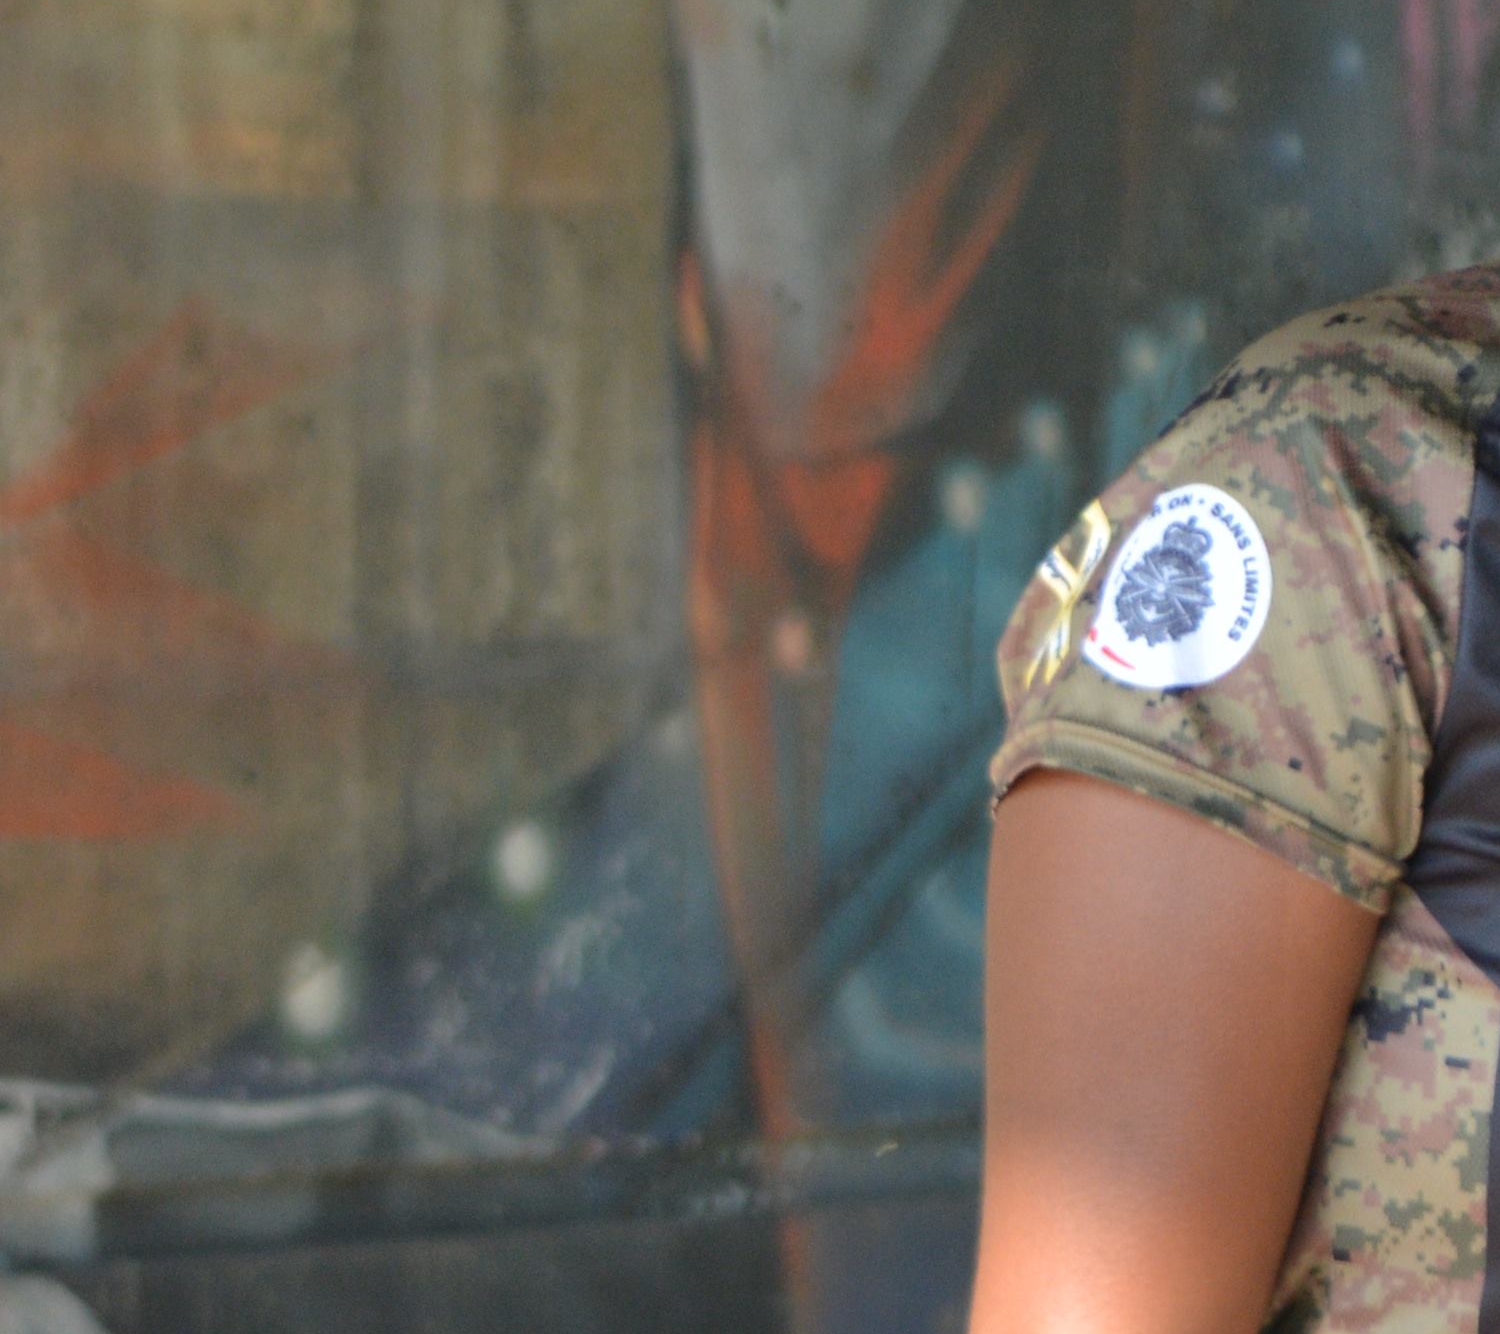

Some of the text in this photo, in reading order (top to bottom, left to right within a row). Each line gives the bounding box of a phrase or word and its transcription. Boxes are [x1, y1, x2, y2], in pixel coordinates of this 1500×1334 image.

[1168, 494, 1194, 511] ON
[1210, 501, 1260, 643] SANS LIMITES
